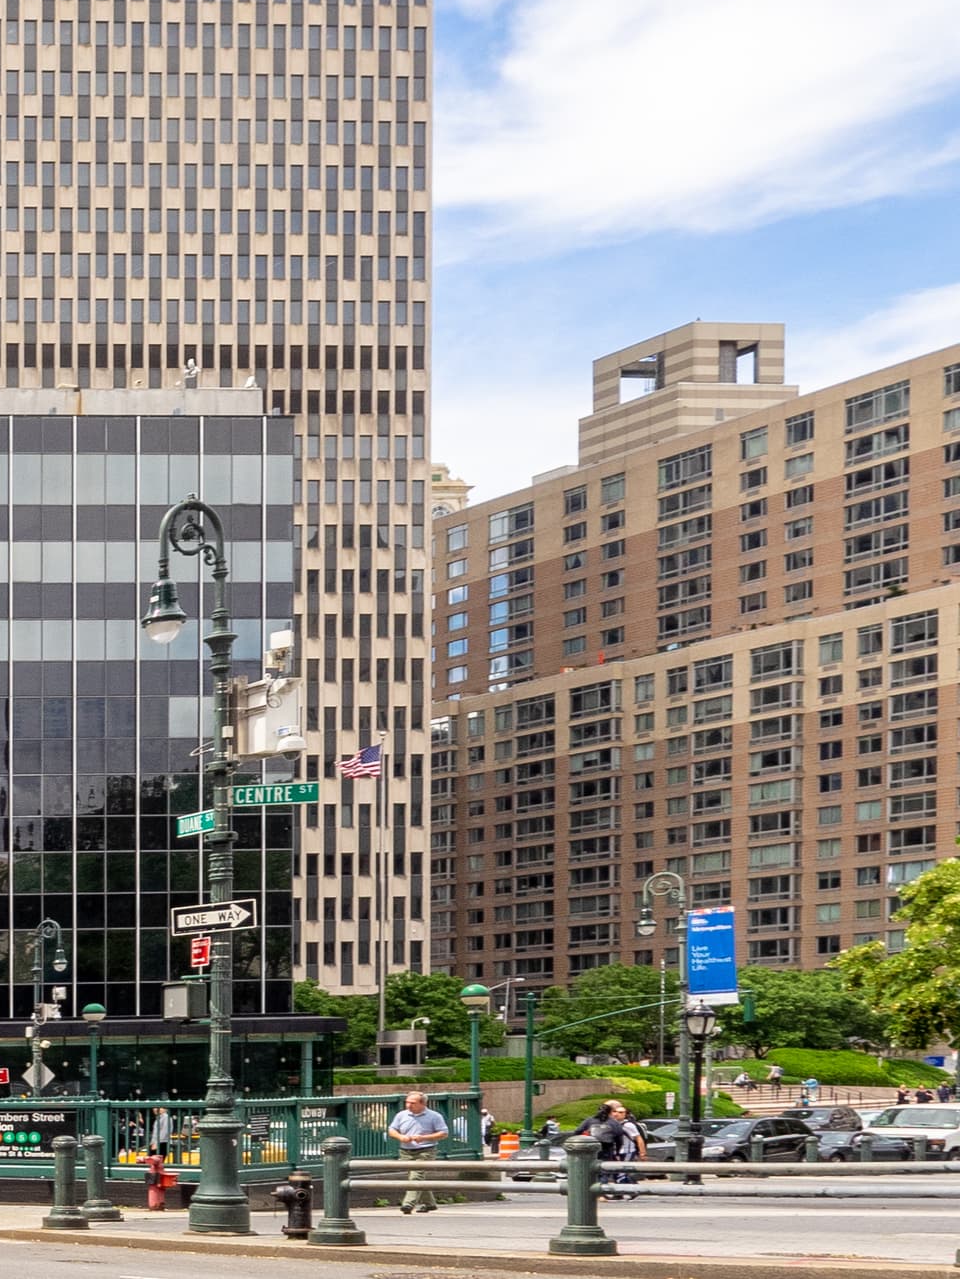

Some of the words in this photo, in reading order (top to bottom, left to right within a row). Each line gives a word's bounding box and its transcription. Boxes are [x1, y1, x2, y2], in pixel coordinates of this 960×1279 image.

[235, 786, 293, 804] CENTRE
[299, 785, 314, 794] ST
[178, 813, 203, 834] DUANE
[205, 812, 214, 821] ST
[184, 914, 207, 926] ONE
[218, 910, 243, 921] WAY
[32, 1112, 65, 1122] Street
[300, 1107, 327, 1119] ubway
